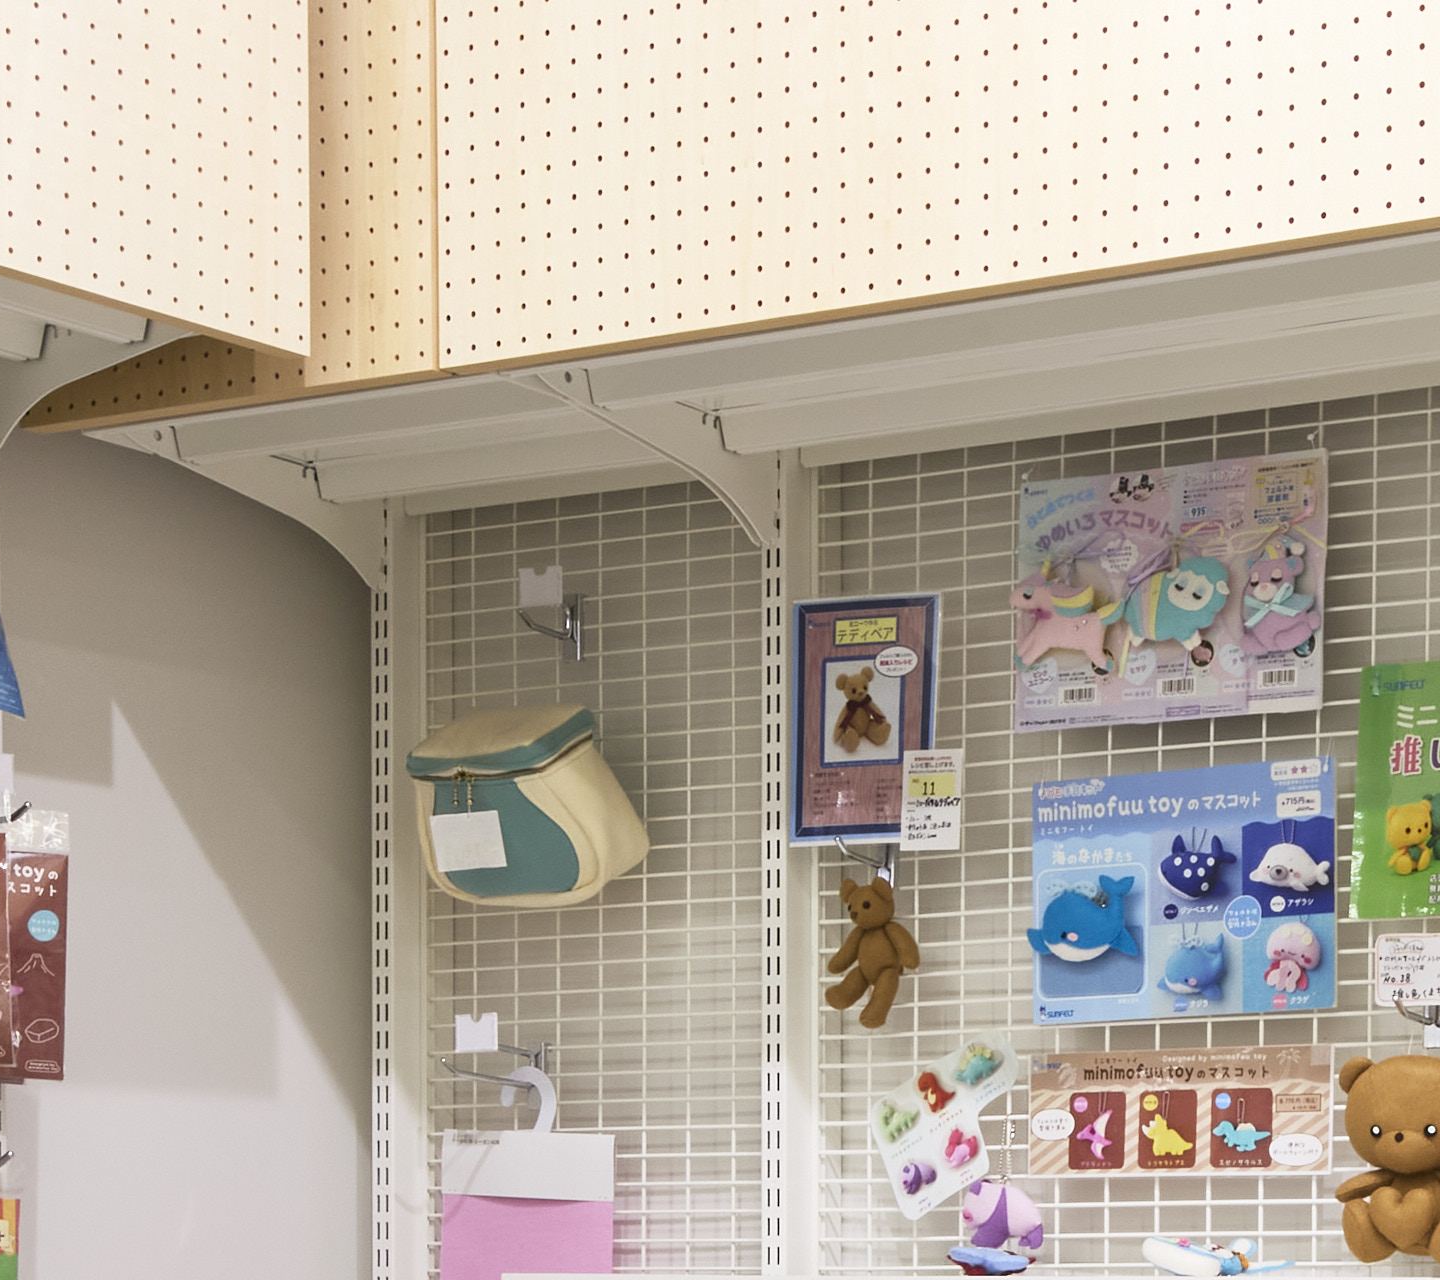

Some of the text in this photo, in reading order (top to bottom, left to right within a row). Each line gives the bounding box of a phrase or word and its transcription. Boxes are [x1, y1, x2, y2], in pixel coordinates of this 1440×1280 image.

[837, 627, 894, 643] テディベア
[922, 781, 936, 796] 11
[1038, 795, 1183, 823] minimofuu toy
[1052, 850, 1134, 865] 海のなかまたち
[1162, 1054, 1195, 1063] Designed
[1084, 1064, 1193, 1082] minimofuu toy
